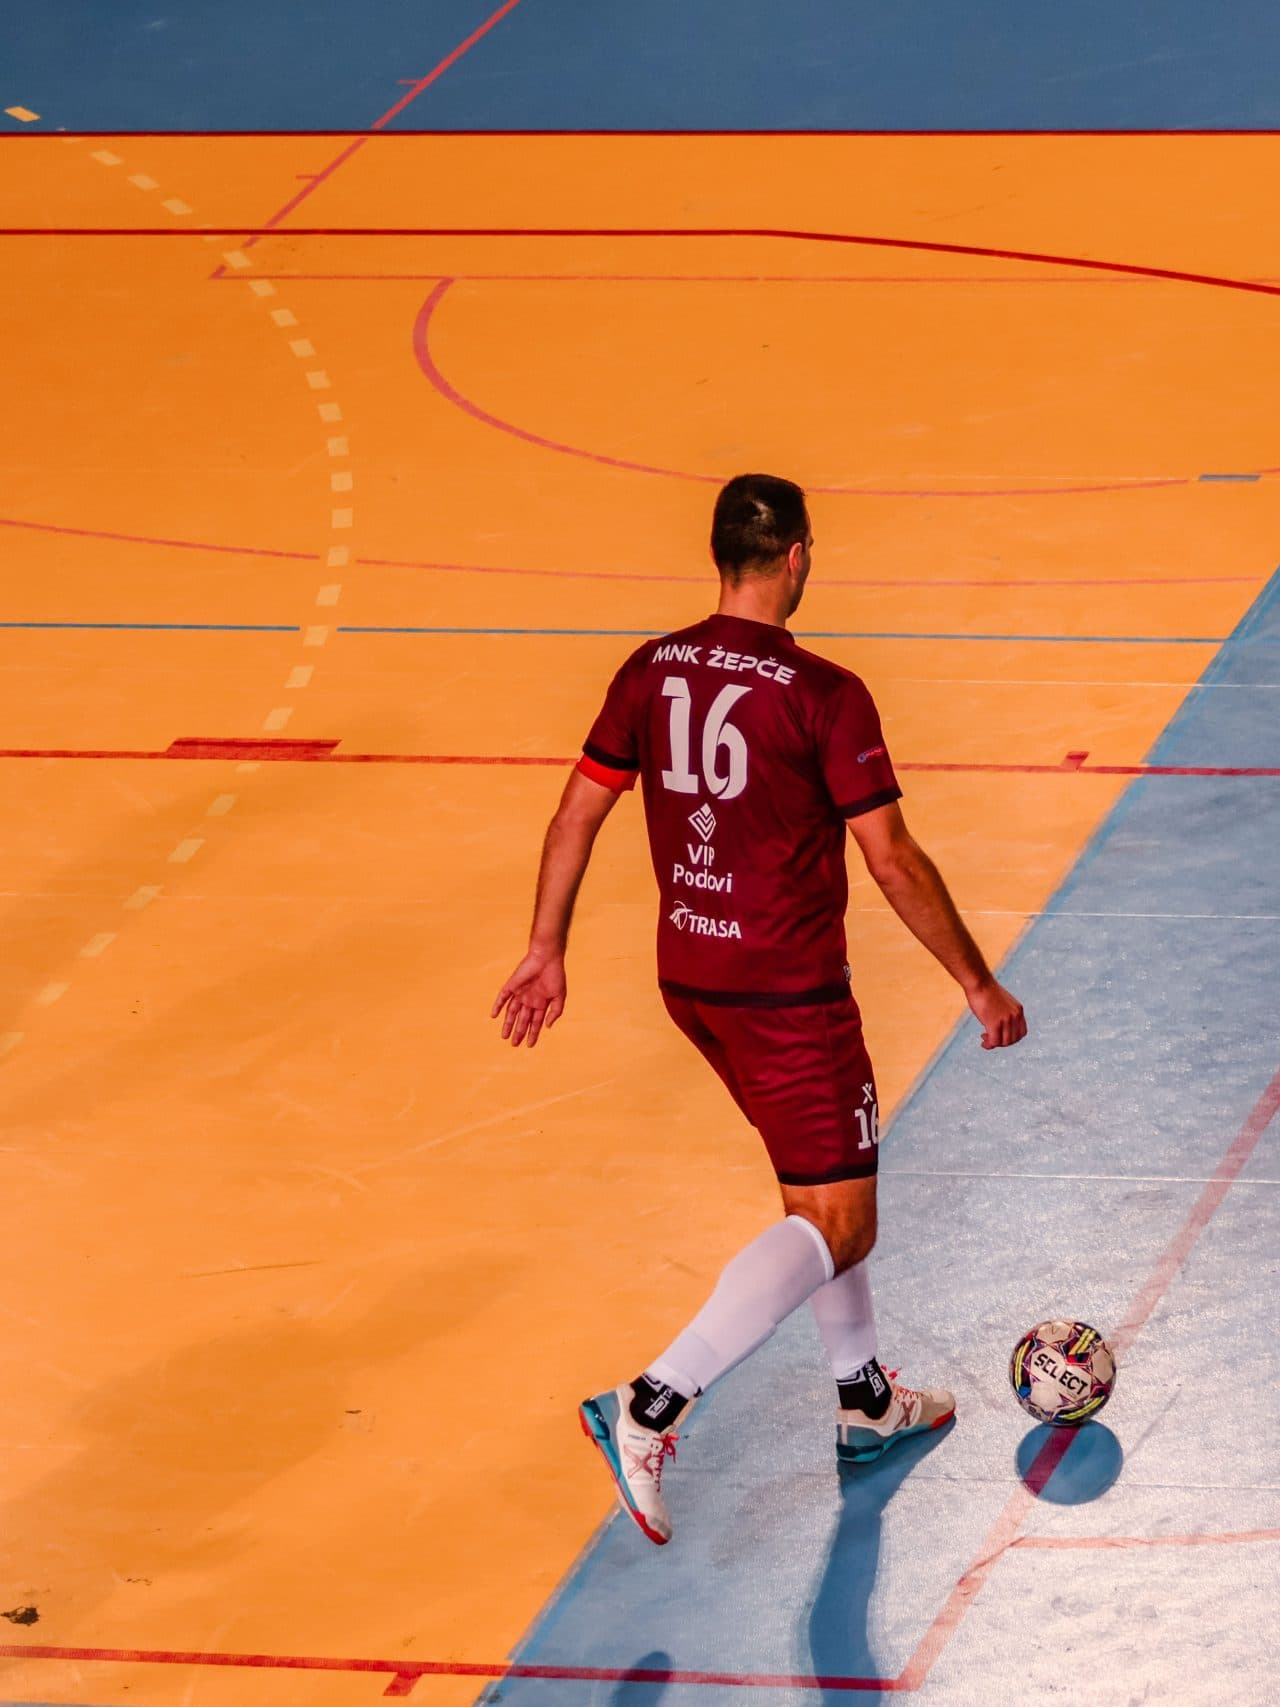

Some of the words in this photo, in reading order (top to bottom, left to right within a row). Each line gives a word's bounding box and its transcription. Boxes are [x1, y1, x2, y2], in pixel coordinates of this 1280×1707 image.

[652, 644, 702, 665] MNK
[706, 645, 797, 685] ŽEPČE
[661, 676, 753, 800] 16
[687, 843, 715, 866] VIP
[673, 863, 733, 894] Podovi
[688, 914, 742, 939] TRASA
[1034, 1353, 1088, 1395] SELECT
